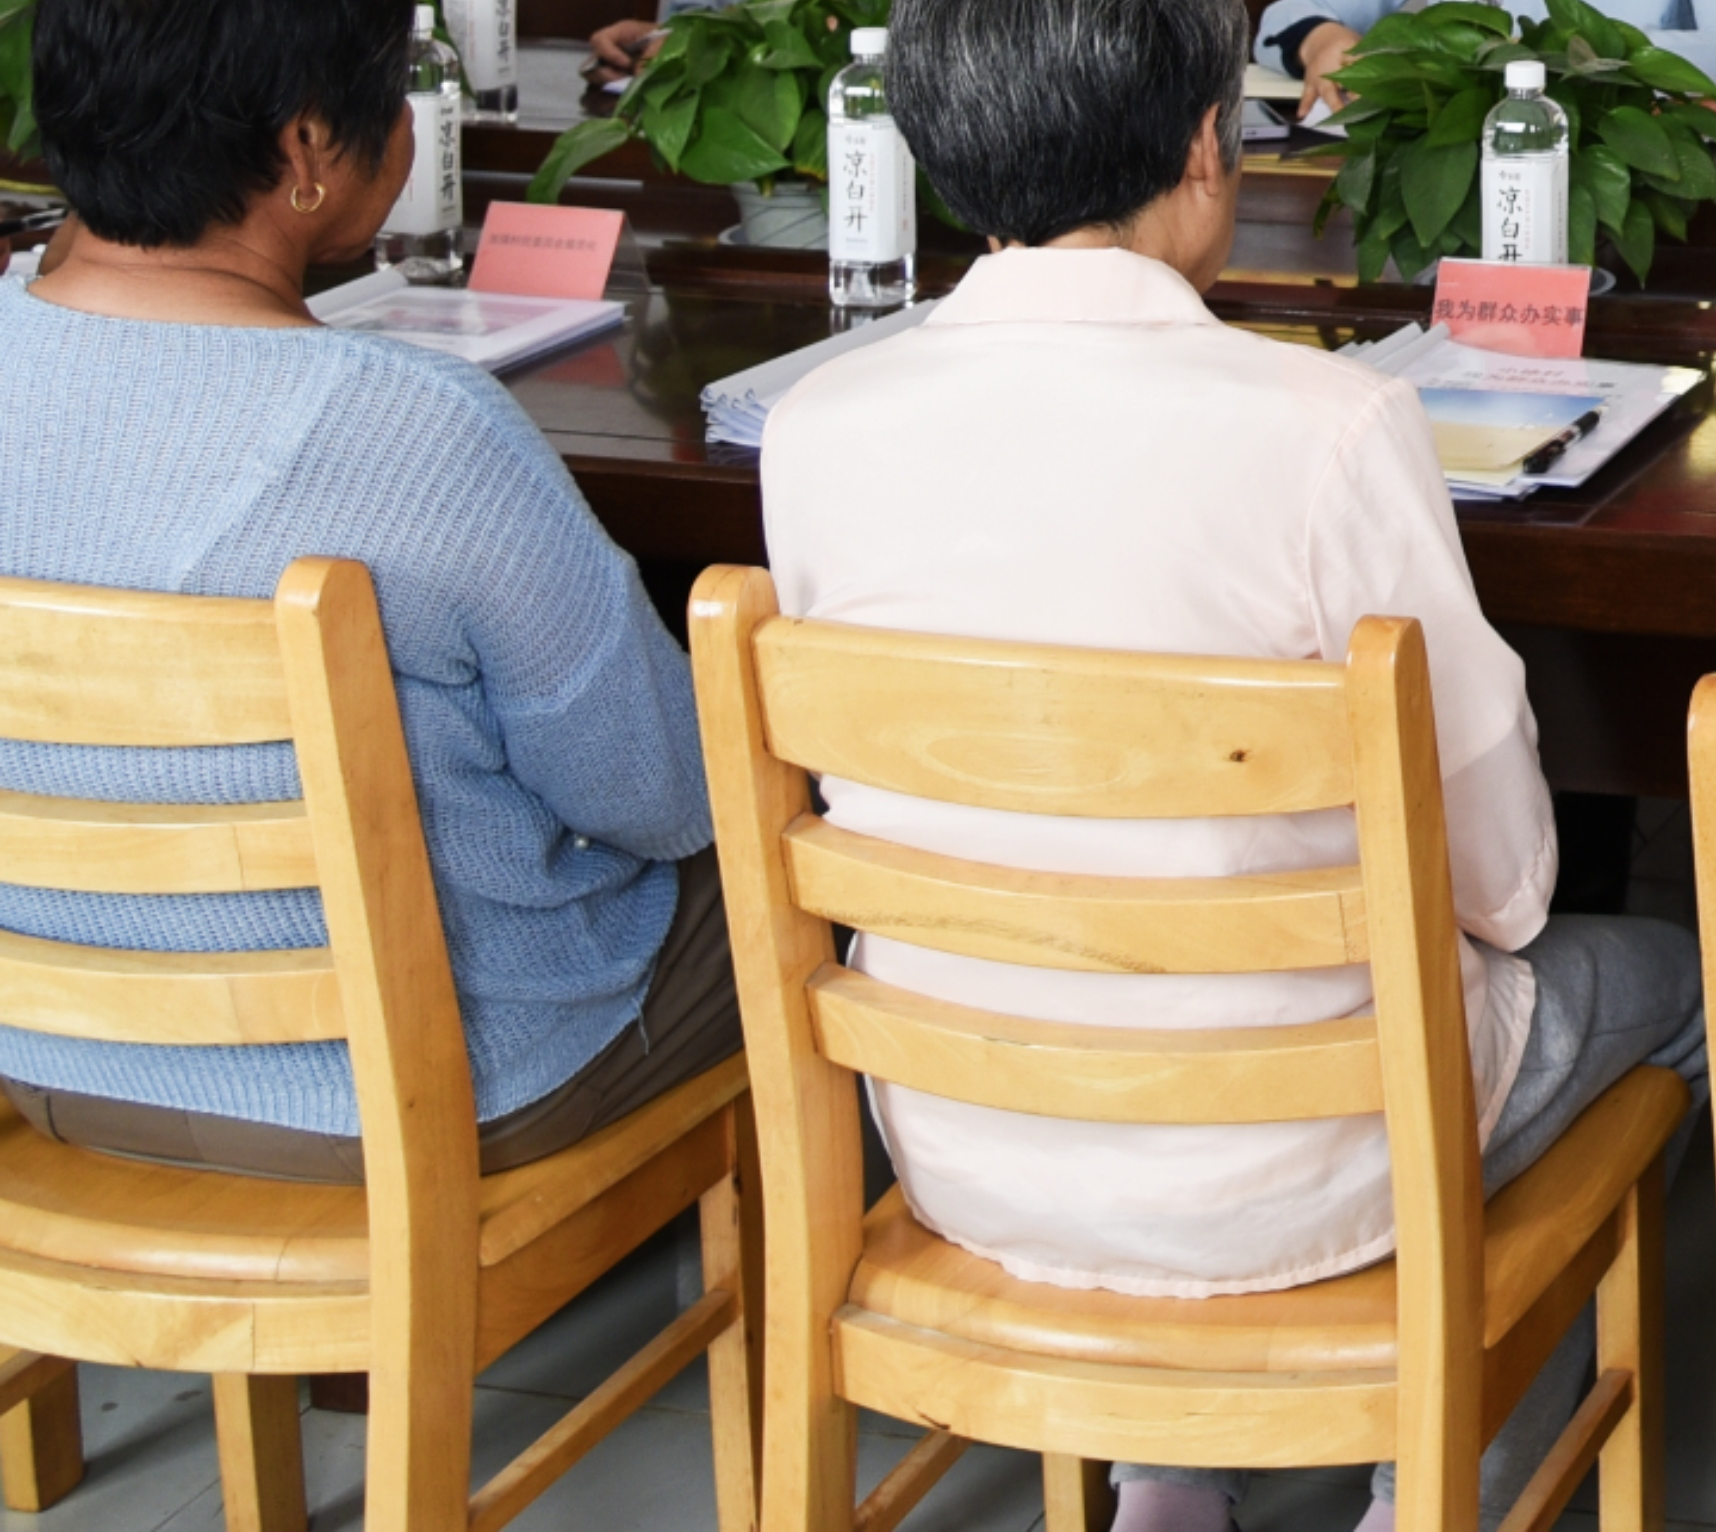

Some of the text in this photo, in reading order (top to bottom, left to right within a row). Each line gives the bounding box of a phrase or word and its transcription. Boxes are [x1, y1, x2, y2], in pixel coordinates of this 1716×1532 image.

[843, 150, 868, 232] 凉白开
[1497, 186, 1523, 262] 凉白开
[1435, 298, 1585, 328] 我为群众办实事
